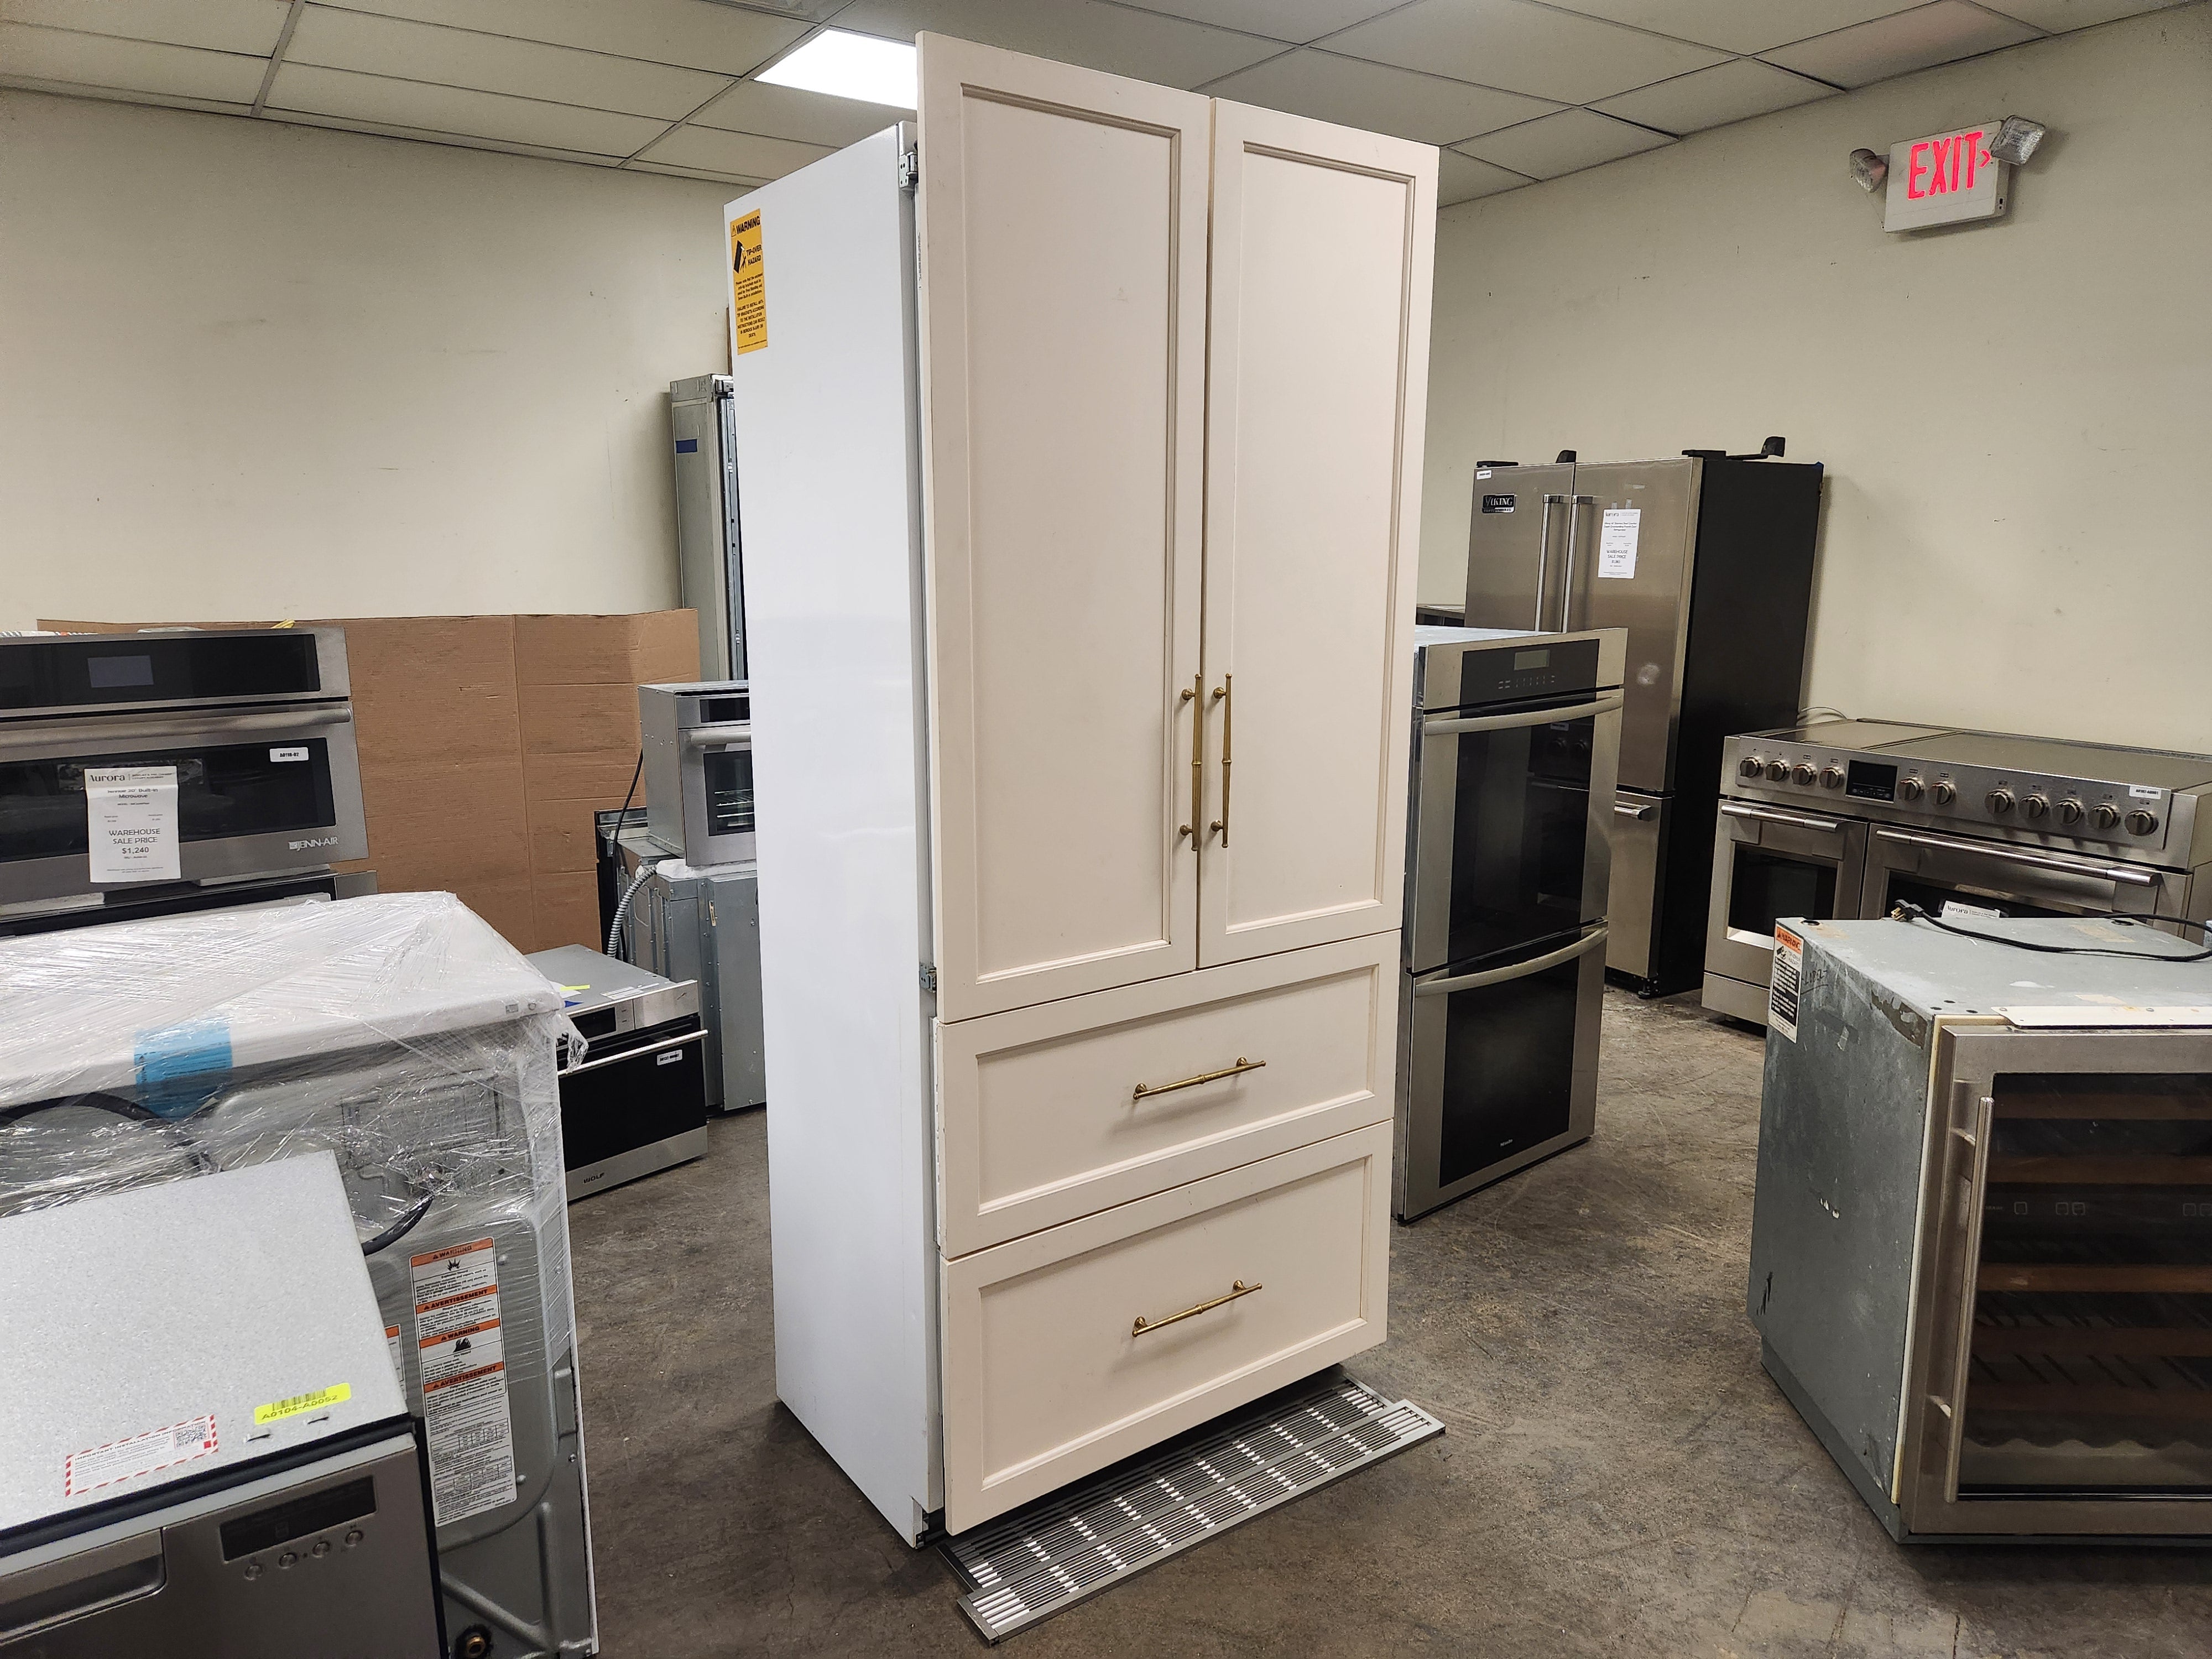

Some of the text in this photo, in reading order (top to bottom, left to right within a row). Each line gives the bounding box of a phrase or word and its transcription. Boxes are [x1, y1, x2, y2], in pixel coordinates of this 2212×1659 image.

[1908, 131, 1984, 200] EXIT
[736, 216, 760, 234] WARNING
[746, 244, 762, 256] TIP-OVER
[748, 255, 761, 265] HAZARD
[1485, 496, 1513, 507] VIKING
[296, 836, 338, 851] JENN-AIR
[1948, 905, 1968, 914] Aurora
[583, 1172, 604, 1183] WOLF
[440, 1245, 472, 1258] WARNING
[431, 1289, 488, 1308] AVERTISSEMENT
[448, 1326, 479, 1338] WARNING
[440, 1366, 496, 1386] AVERTISSEMENT
[75, 1447, 114, 1462] IMPORTANT
[115, 1434, 161, 1450] INSTALLATION
[162, 1421, 206, 1437] INFORMATION
